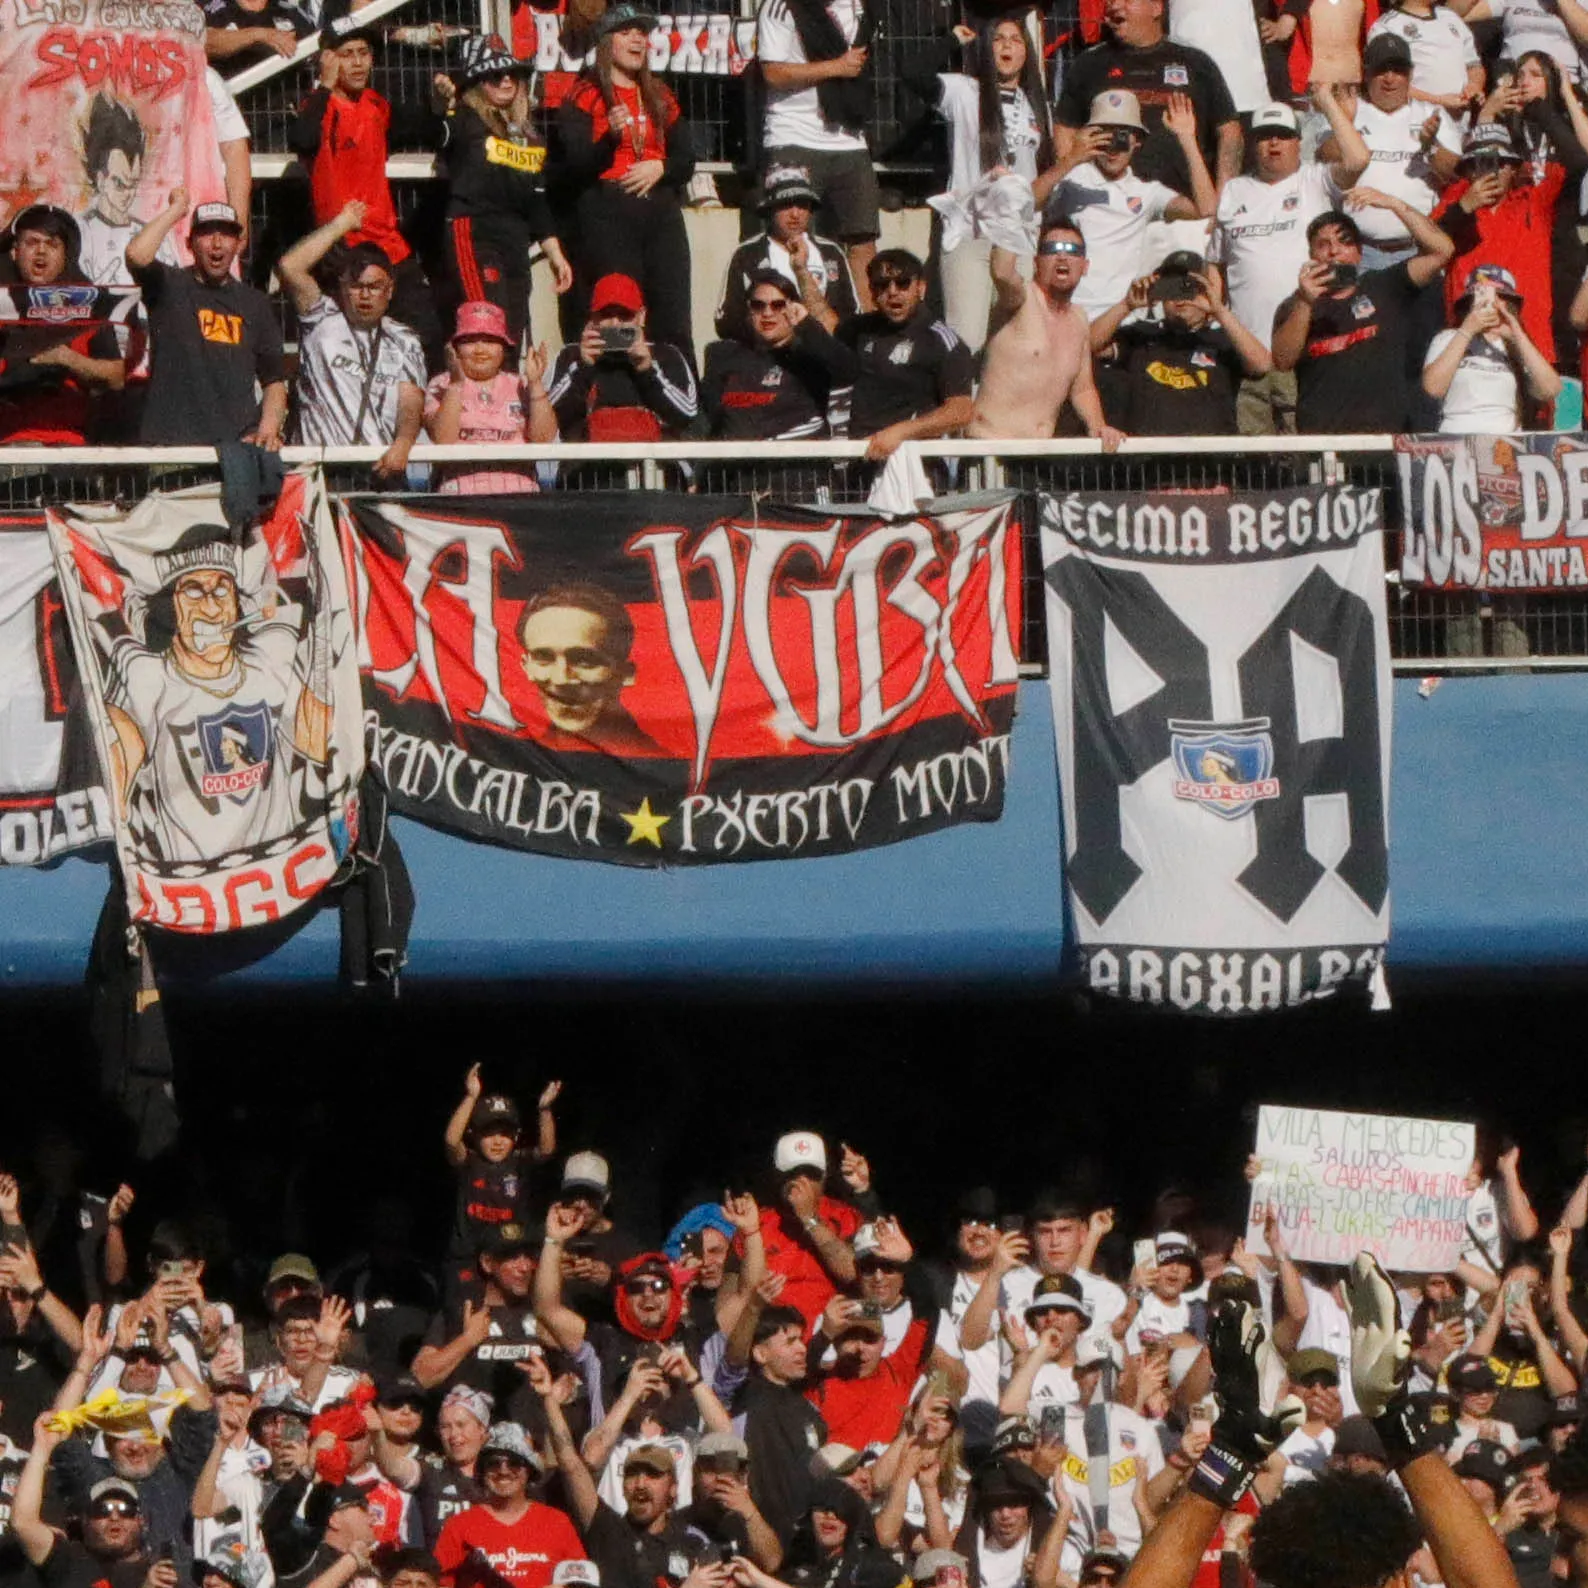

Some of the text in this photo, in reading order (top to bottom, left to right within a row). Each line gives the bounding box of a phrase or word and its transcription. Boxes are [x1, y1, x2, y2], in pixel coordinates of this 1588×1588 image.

[27, 29, 188, 102] SOMOS
[196, 308, 240, 343] CAT
[1400, 451, 1482, 588] LOS
[1487, 547, 1588, 588] SANTA
[892, 734, 1011, 823] MONT
[1260, 1107, 1469, 1162] VILLA MERCEDES
[1311, 1146, 1403, 1170] SALUDOS
